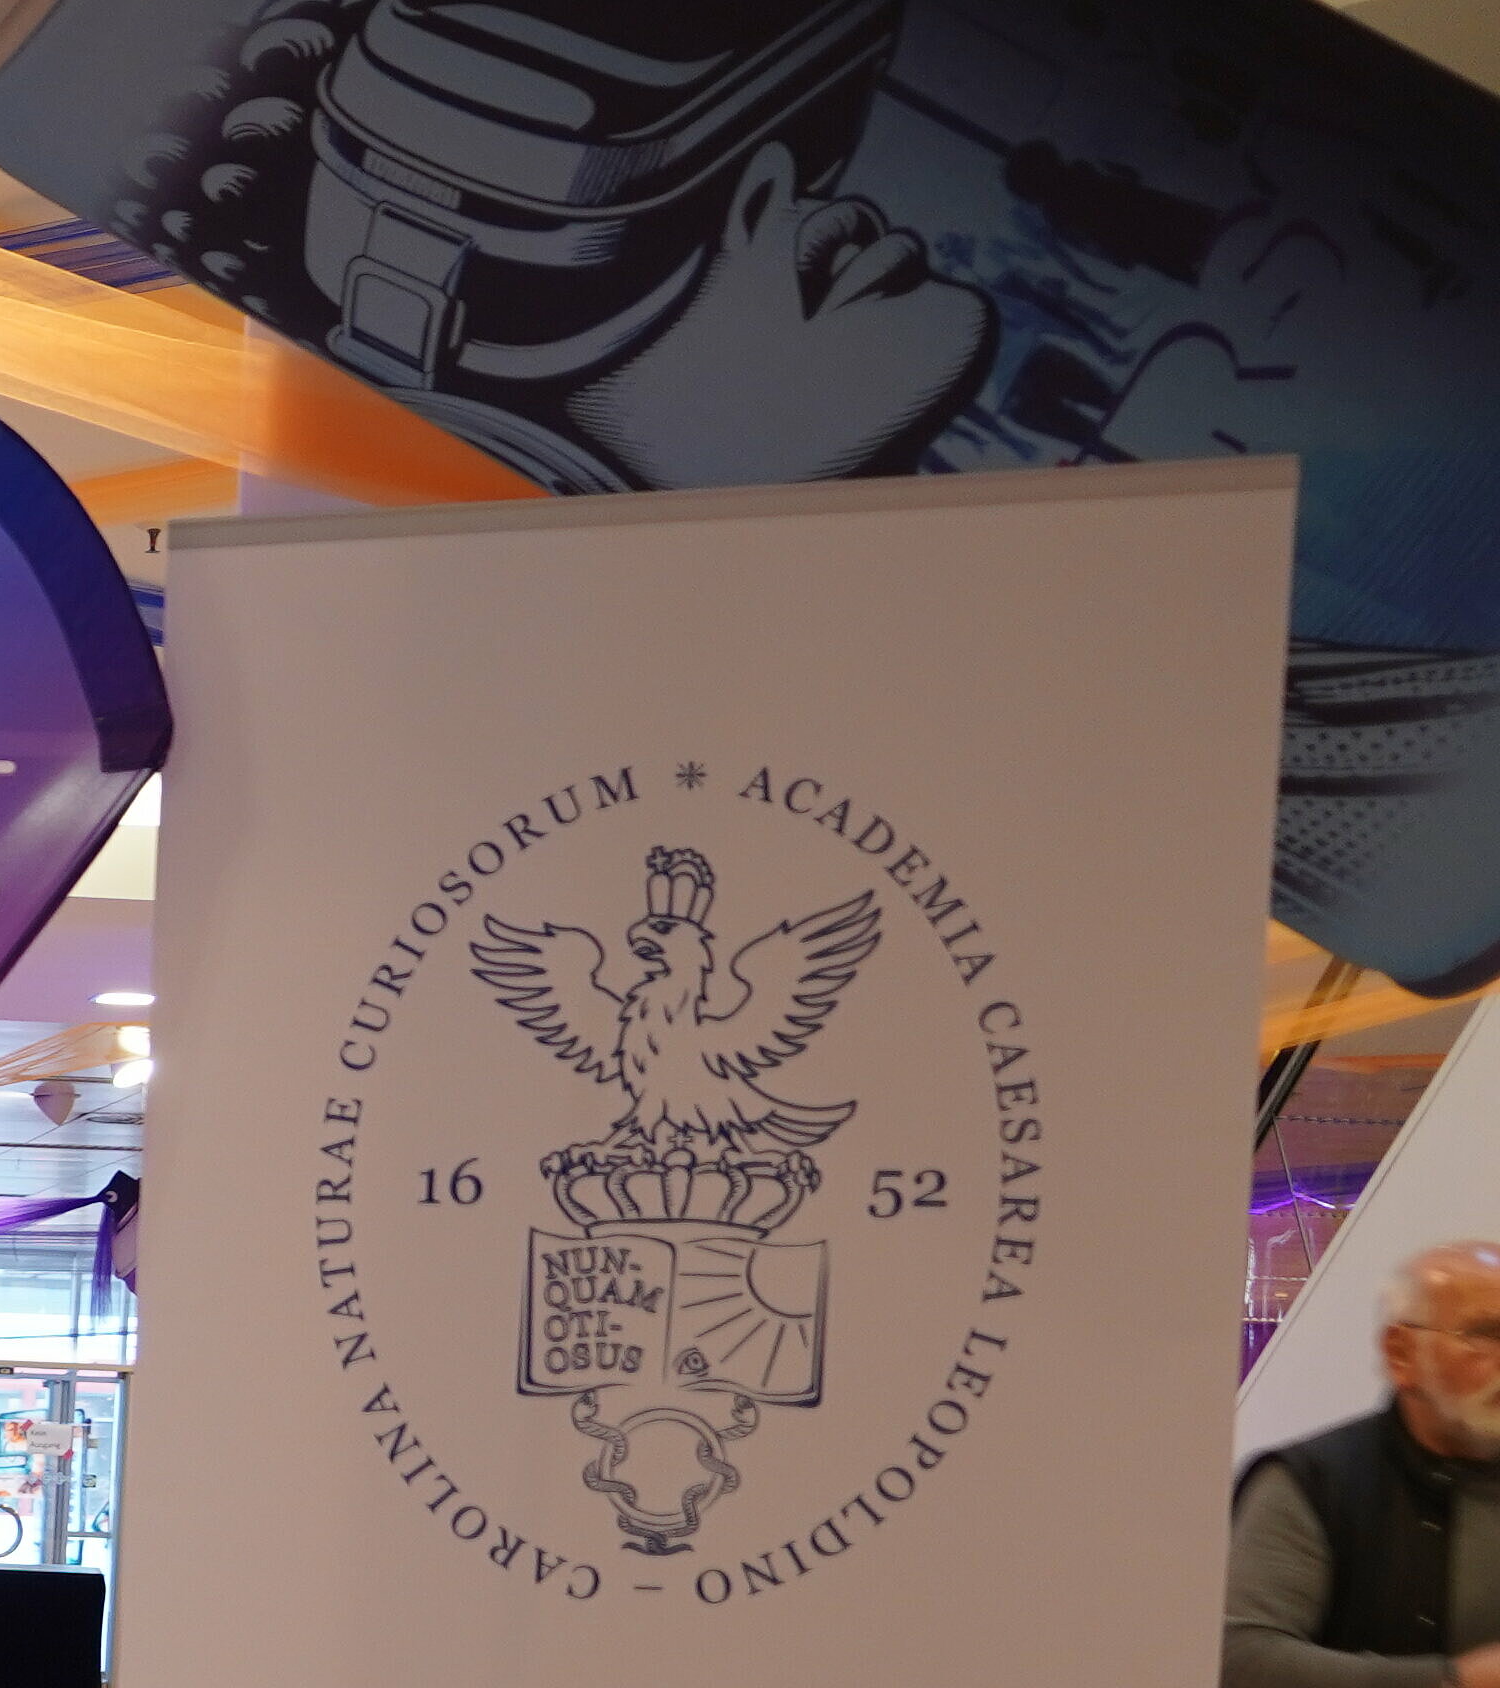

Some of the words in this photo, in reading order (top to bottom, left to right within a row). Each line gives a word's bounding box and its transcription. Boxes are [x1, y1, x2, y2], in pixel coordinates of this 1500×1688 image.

[341, 764, 641, 1071] CURIOSORUM
[739, 765, 997, 989] ACADEMIA
[316, 1094, 381, 1373] NATURAE
[417, 1157, 483, 1208] 16
[866, 1169, 950, 1220] 52
[542, 1247, 642, 1279] NUN-
[976, 1001, 1048, 1308] CAESAREA
[544, 1276, 664, 1313] QUAM
[544, 1311, 622, 1342] OTI-
[545, 1343, 644, 1374] OSUS
[360, 1381, 602, 1602] CAROLINA
[696, 1327, 1005, 1606] LEOPOLDINO
